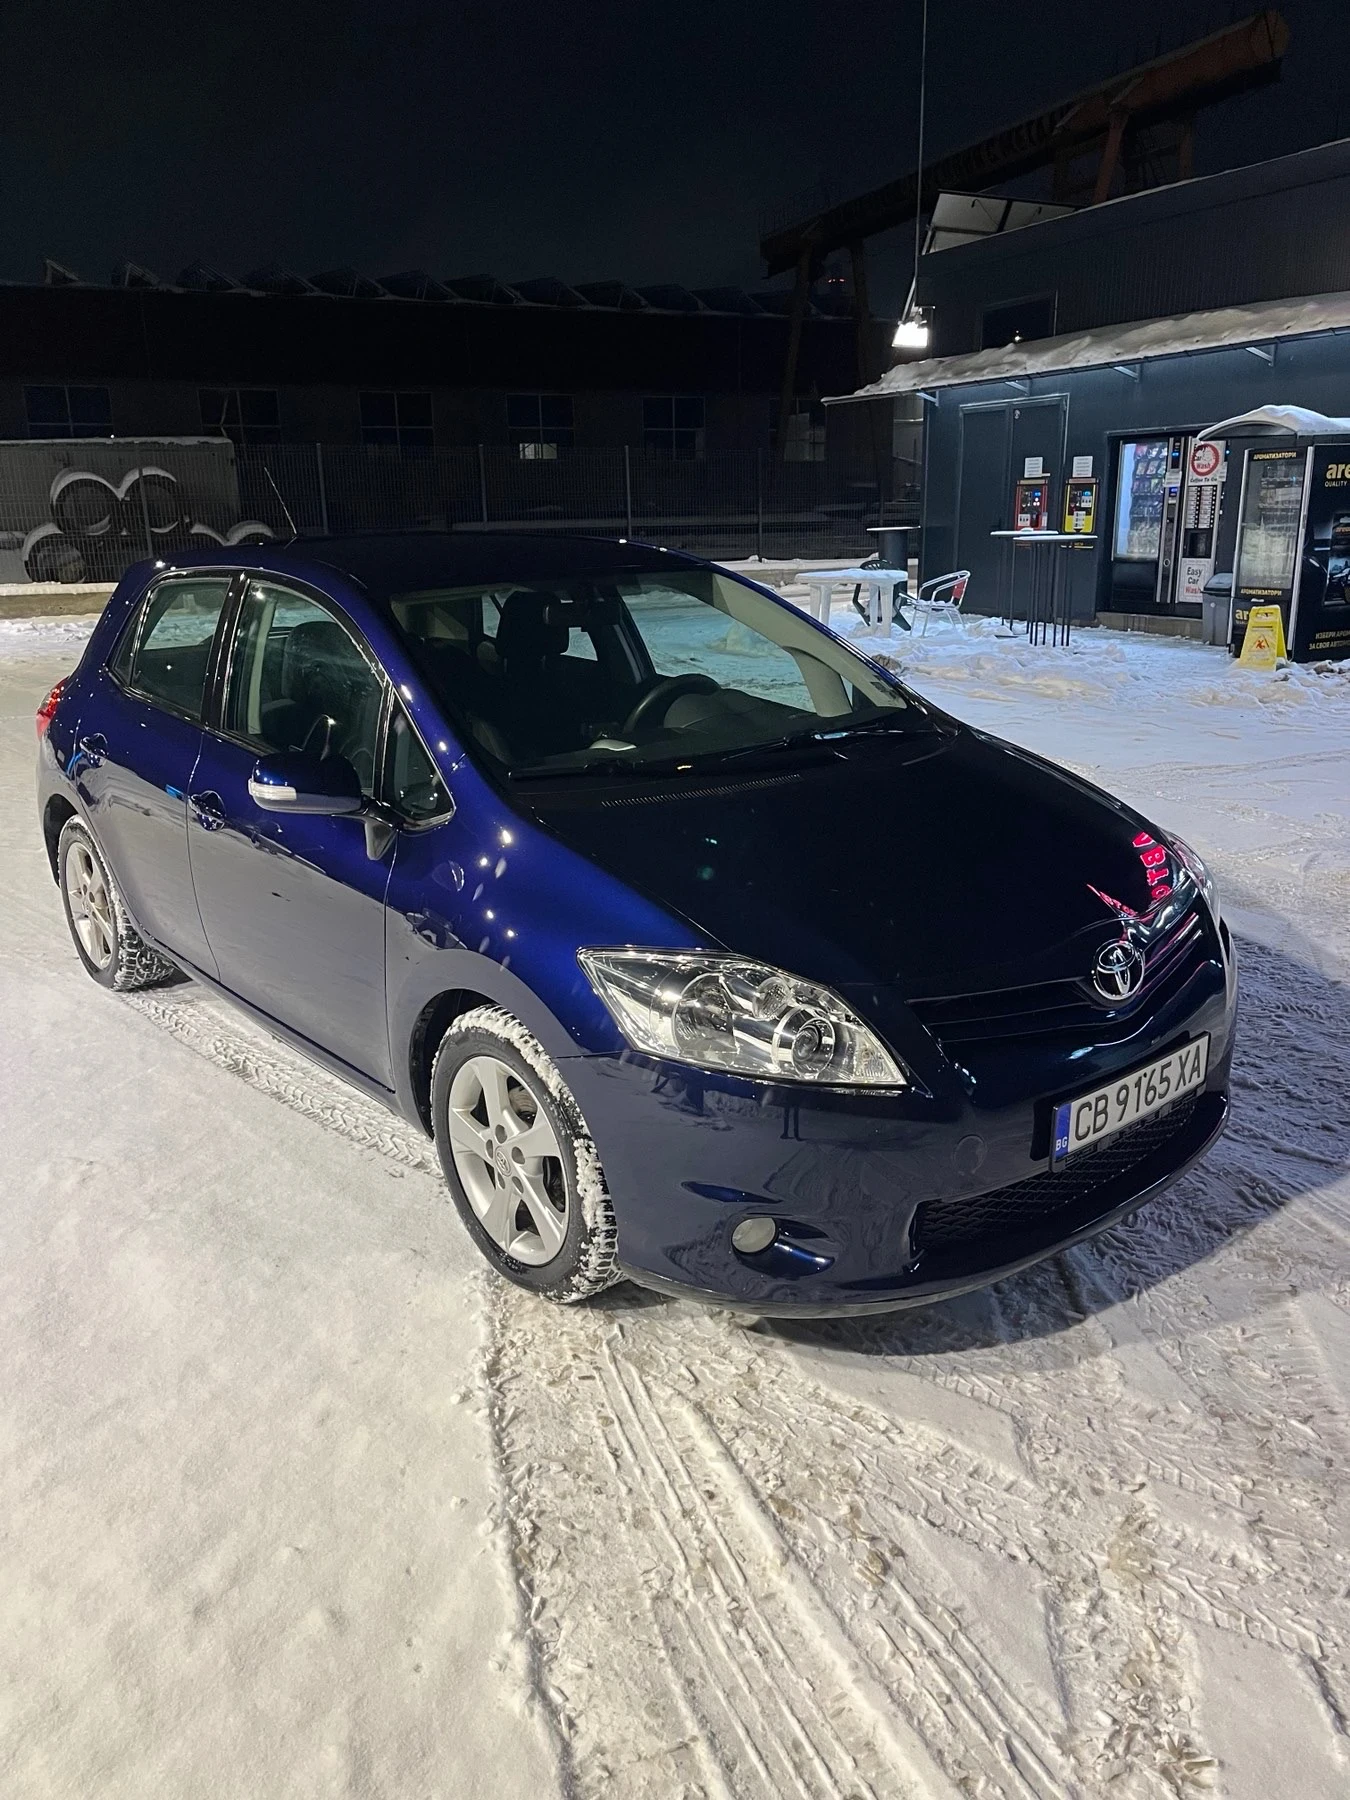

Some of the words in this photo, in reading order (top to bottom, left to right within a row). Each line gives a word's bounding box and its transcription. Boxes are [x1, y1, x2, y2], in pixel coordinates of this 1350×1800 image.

[1253, 452, 1297, 460] АРОМАТИЗАТОРИ
[1187, 567, 1203, 578] Easy
[1074, 1094, 1109, 1142] CB
[1116, 1060, 1172, 1123] 9165
[1174, 1044, 1201, 1092] XA
[1055, 1136, 1068, 1151] BG
